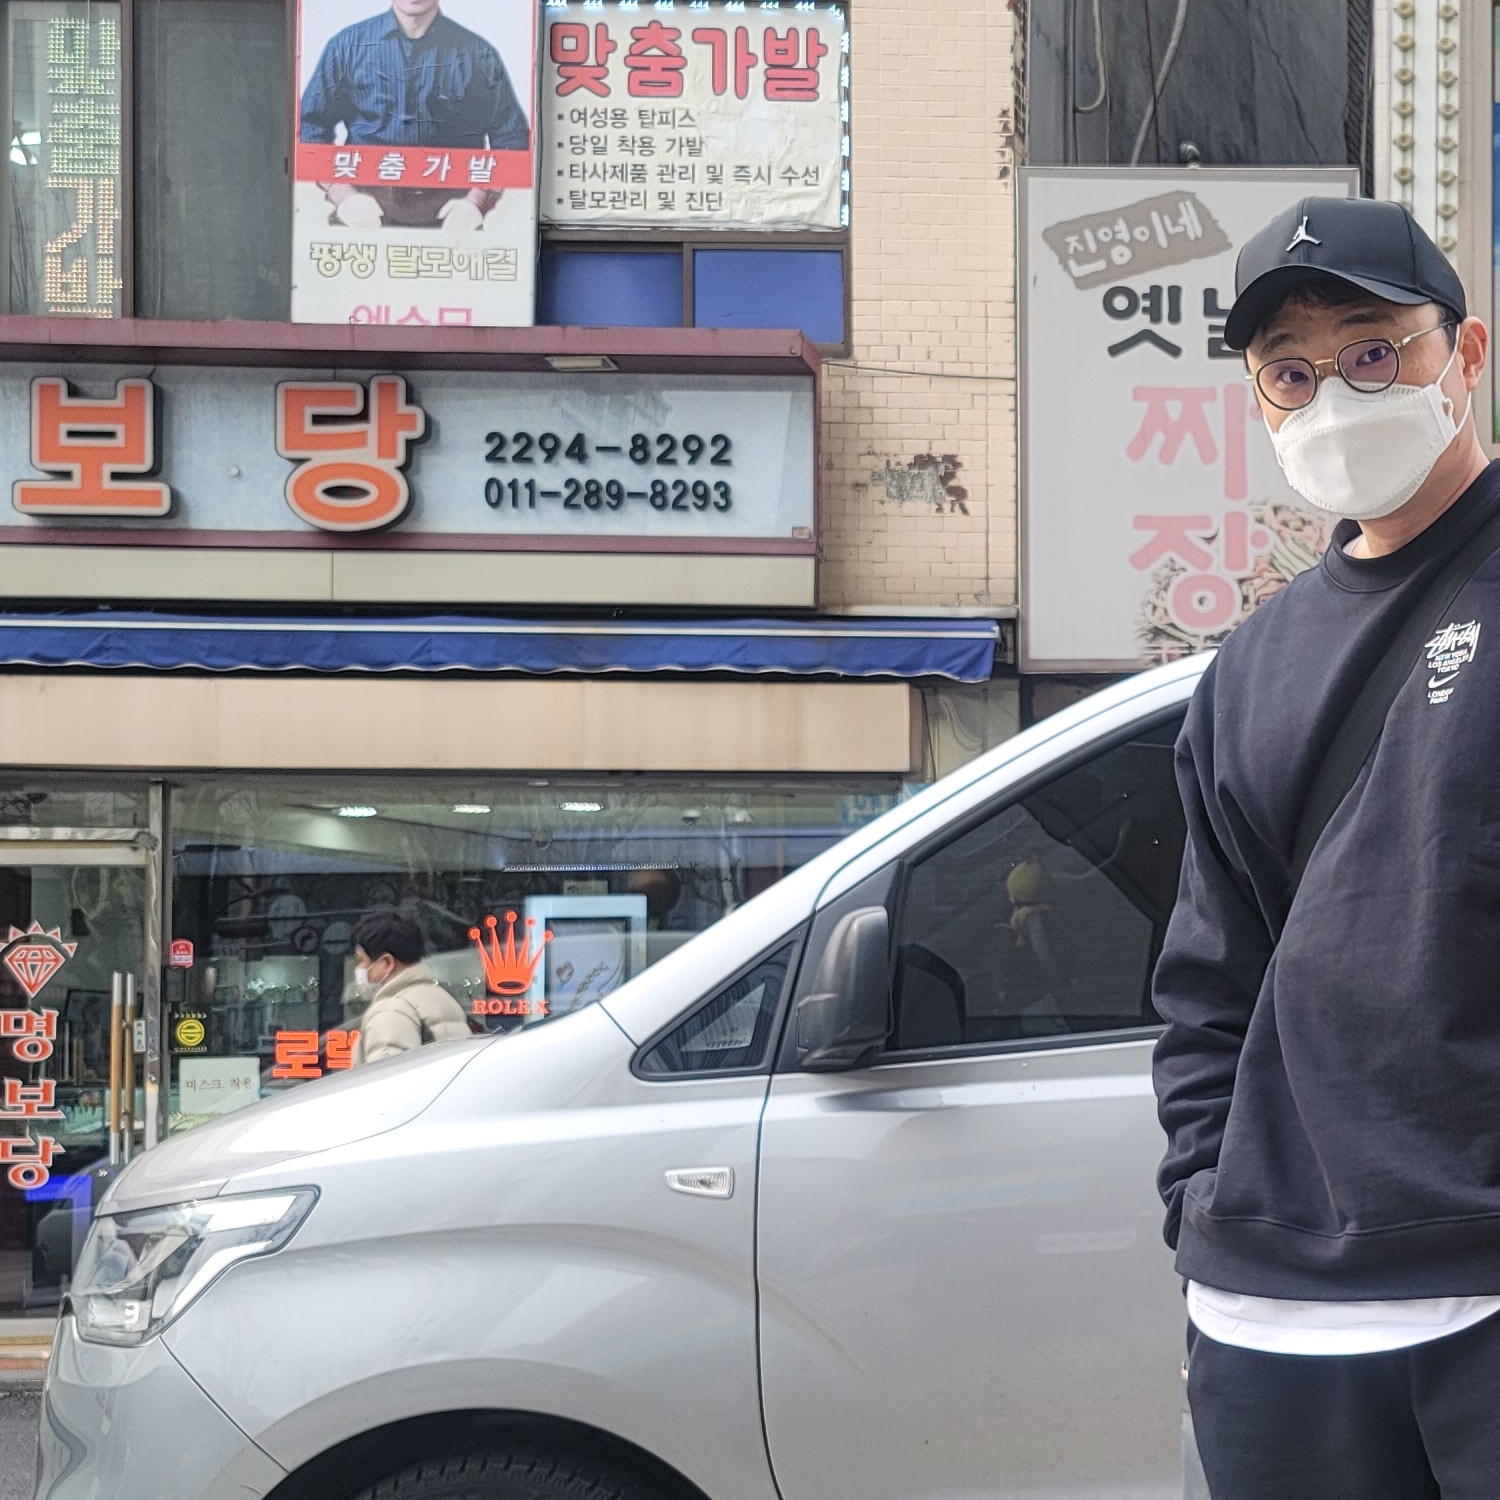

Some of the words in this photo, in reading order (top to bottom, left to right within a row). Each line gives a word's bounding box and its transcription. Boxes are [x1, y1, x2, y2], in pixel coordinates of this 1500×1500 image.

[550, 20, 828, 102] 맞춤가발
[570, 108, 629, 129] 여성용
[638, 108, 697, 130] 탑피스
[569, 135, 608, 156] 당일
[617, 136, 656, 157] 착용
[665, 137, 703, 158] 가발
[334, 151, 497, 184] 맞춤가발
[569, 163, 648, 184] 타사제품
[657, 163, 696, 184] 관리
[706, 164, 724, 185] 및
[733, 165, 772, 186] 즉시
[780, 166, 820, 187] 수선
[569, 189, 648, 210] 탈모관리
[658, 190, 676, 210] 및
[685, 191, 723, 212] 진단
[1064, 200, 1202, 278] 진영이네
[310, 242, 378, 278] 평생
[485, 432, 733, 467] 2294-8292
[484, 478, 733, 513] 011-289-8293
[472, 999, 550, 1016] ROLEX
[0, 1006, 67, 1190] 명보당
